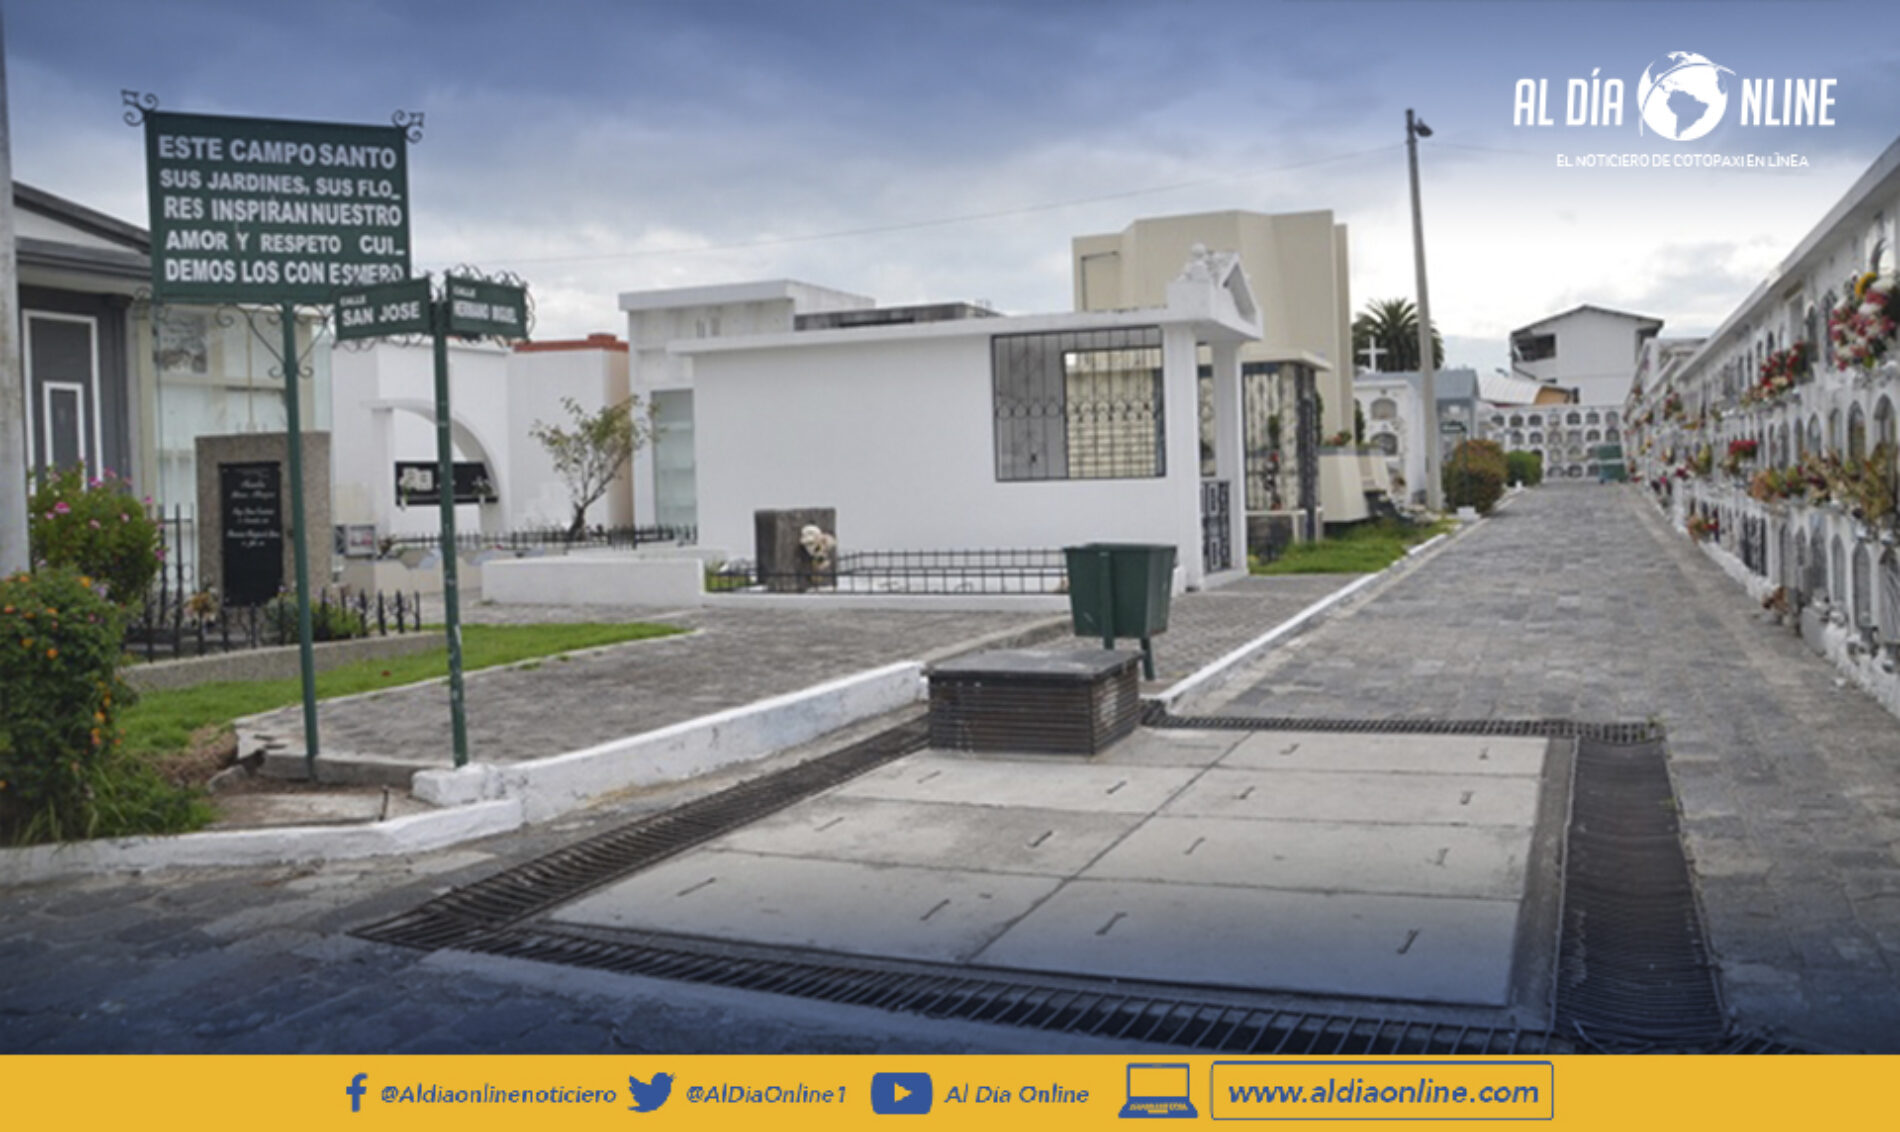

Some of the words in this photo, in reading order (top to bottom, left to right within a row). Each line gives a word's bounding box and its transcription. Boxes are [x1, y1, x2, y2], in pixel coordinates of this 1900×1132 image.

[159, 136, 224, 160] ESTE
[229, 139, 316, 166] CAMPO
[319, 143, 397, 169] SANTO
[160, 168, 202, 190] SUS
[207, 172, 310, 195] JARDINES,
[316, 176, 353, 197] SUS
[164, 196, 204, 219] RES
[211, 198, 308, 224] INSPIRAN
[310, 203, 402, 226] NUESTRO
[165, 230, 229, 250] AMOR
[235, 232, 250, 251] Y
[260, 233, 342, 254] RESPETO
[164, 259, 236, 282] DEMOS
[241, 260, 280, 283] LOS
[283, 261, 325, 284] CON
[328, 262, 405, 286] ESMERO
[342, 307, 374, 327] SAN
[379, 301, 420, 322] JOSE
